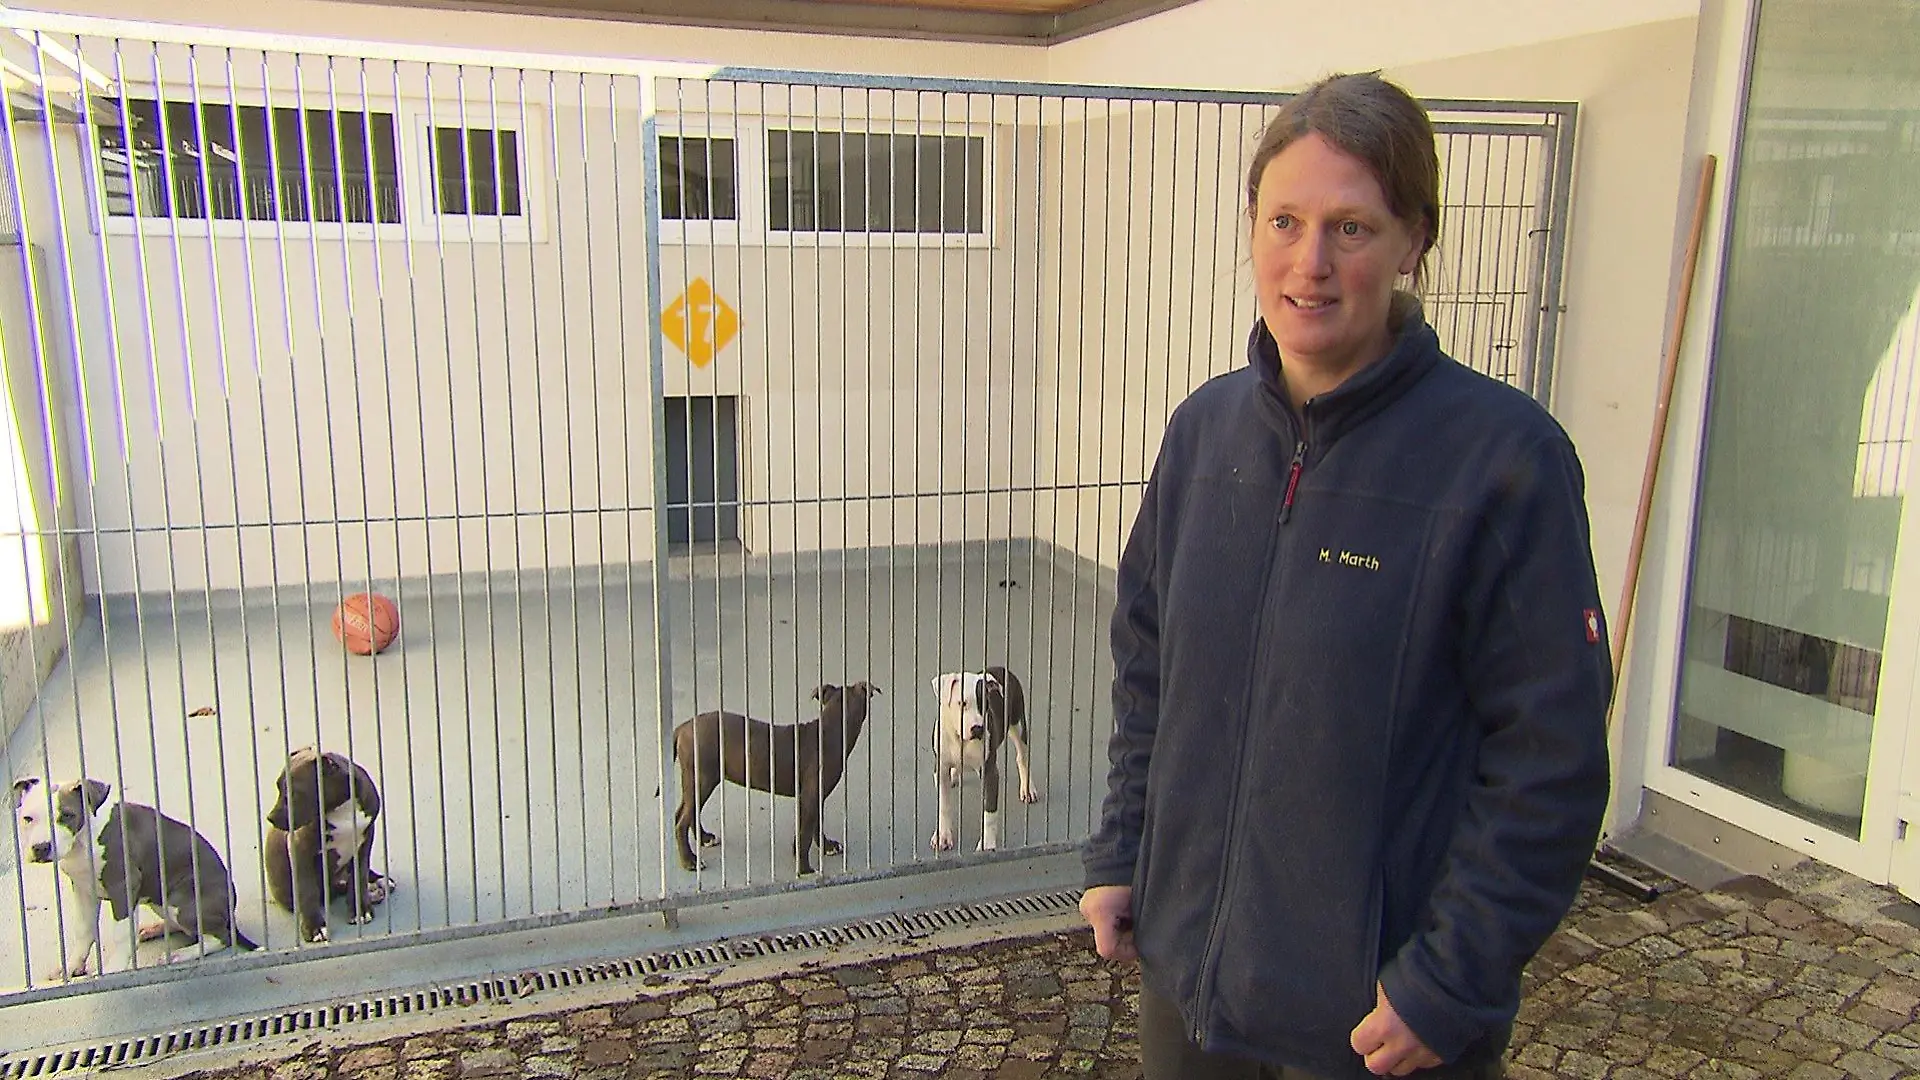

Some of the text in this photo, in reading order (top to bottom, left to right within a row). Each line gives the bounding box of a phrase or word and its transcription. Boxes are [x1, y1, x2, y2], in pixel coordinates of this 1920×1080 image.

[675, 303, 722, 344] 17
[1319, 547, 1380, 571] M. Marth
